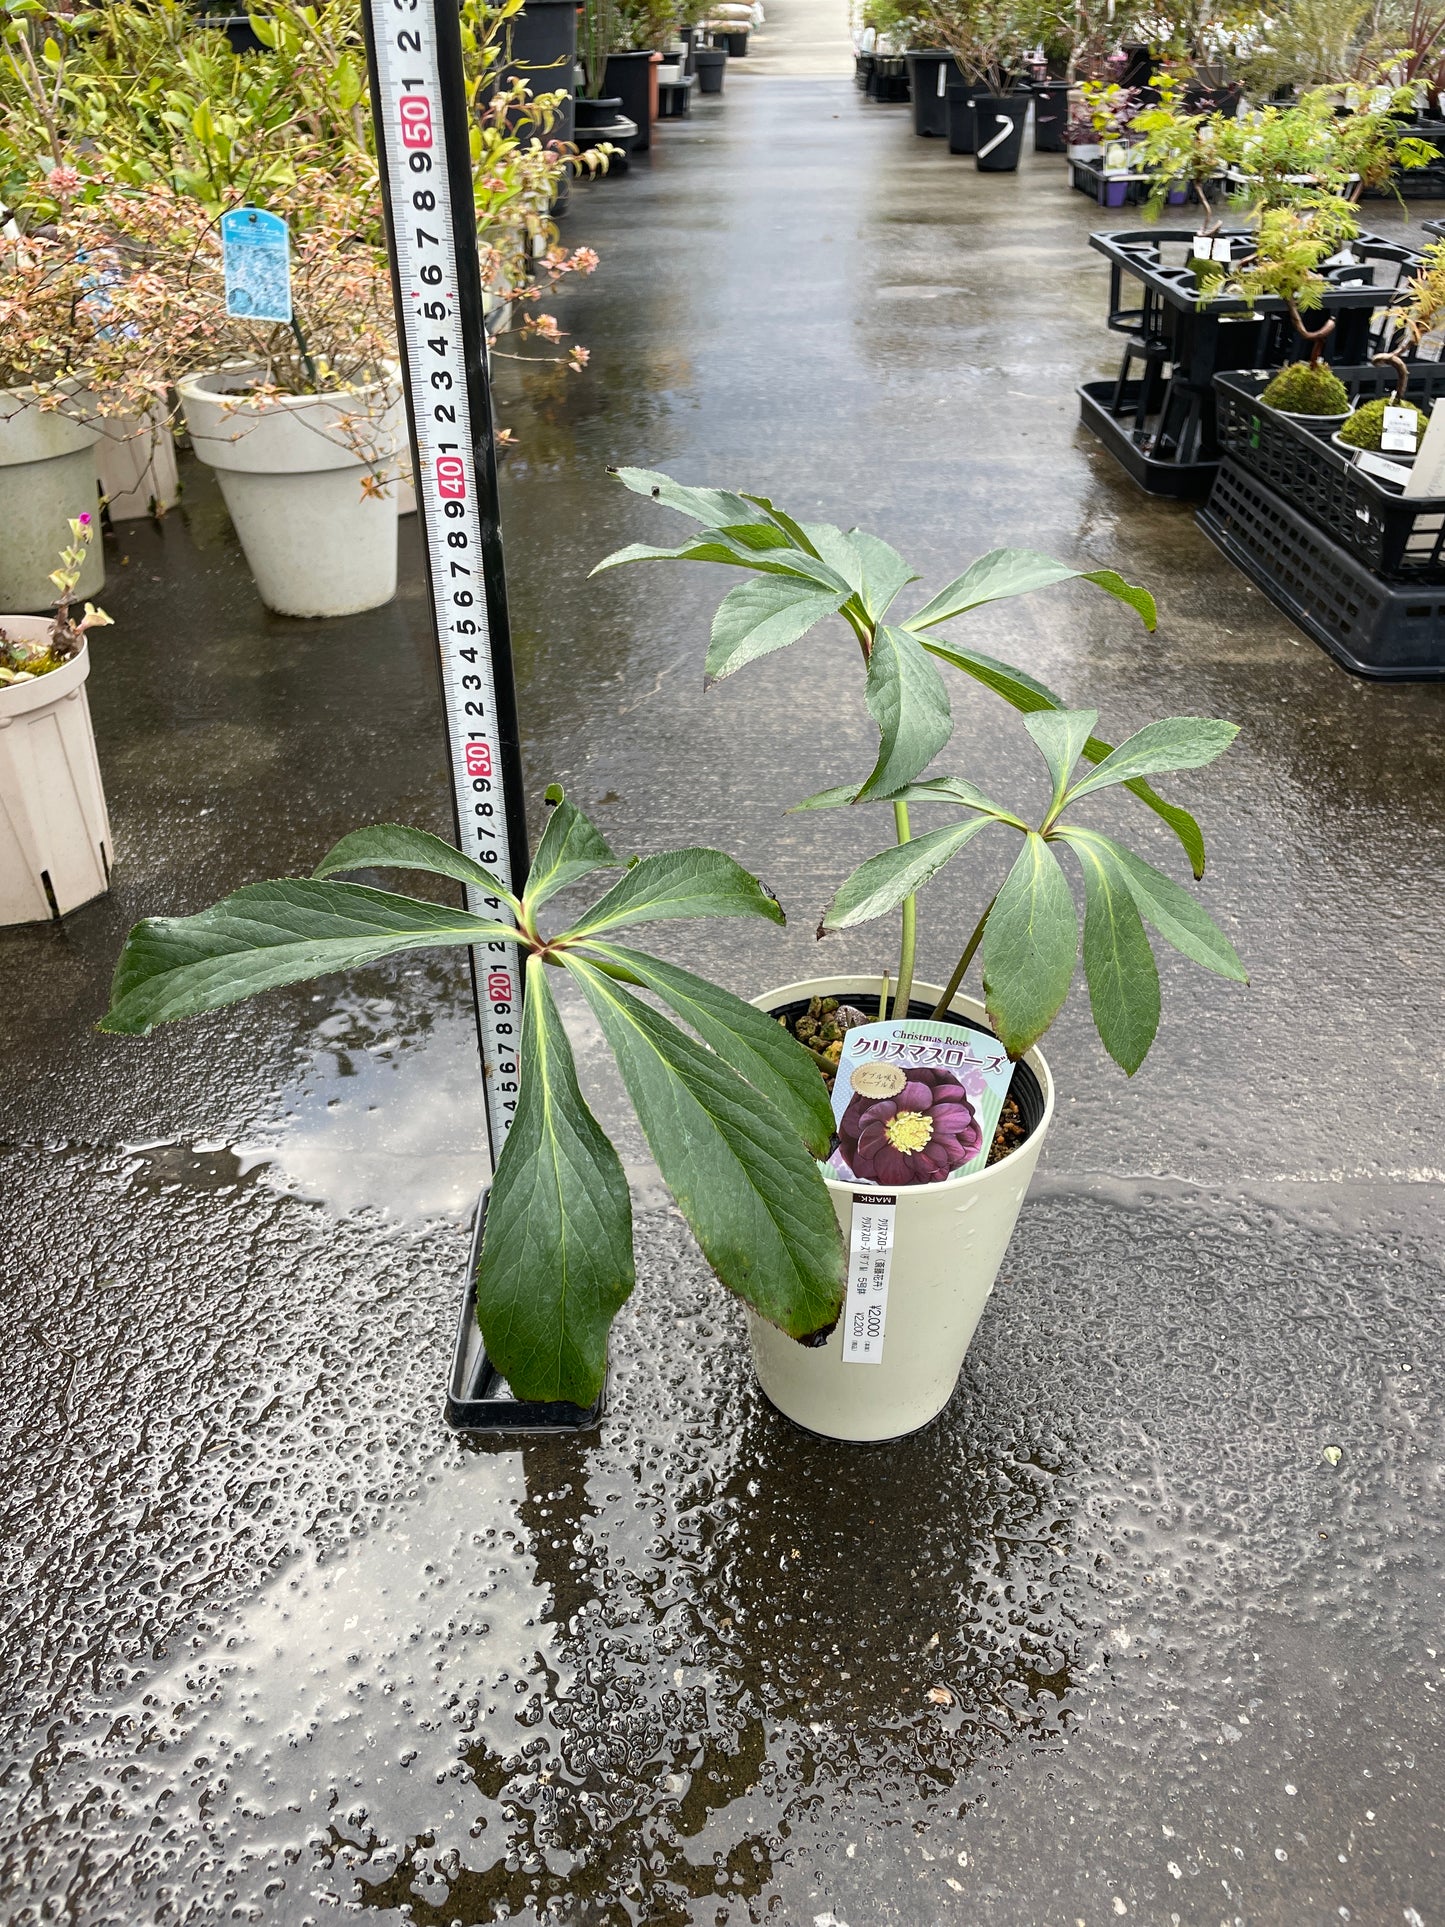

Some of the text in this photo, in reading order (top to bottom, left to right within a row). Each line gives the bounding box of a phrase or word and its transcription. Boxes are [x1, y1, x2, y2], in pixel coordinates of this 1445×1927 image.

[397, 31, 422, 52] 2
[401, 78, 424, 91] 1
[402, 103, 431, 142] 50
[409, 152, 432, 173] 9
[413, 191, 436, 211] 8
[416, 228, 439, 248] 7
[420, 265, 443, 285] 6
[424, 301, 446, 321] 5
[428, 336, 449, 356] 4
[431, 371, 453, 390] 3
[434, 404, 456, 423] 2
[438, 443, 459, 454] 1
[439, 461, 464, 494] 40
[444, 501, 465, 518] 9
[447, 531, 468, 549] 8
[450, 561, 471, 578] 7
[453, 591, 474, 607] 6
[457, 619, 476, 635] 5
[459, 647, 479, 663] 4
[462, 674, 482, 690] 3
[465, 701, 484, 717] 2
[468, 732, 486, 741] 1
[467, 746, 490, 772] 30
[472, 778, 492, 793] 9
[475, 802, 494, 817] 8
[477, 827, 496, 840] 7
[480, 850, 498, 864] 6
[484, 896, 501, 909] 4
[491, 964, 507, 972] 1
[490, 976, 510, 998] 20
[494, 1003, 511, 1015] 9
[496, 1022, 513, 1035] 8
[892, 1029, 969, 1047] Christmas Rose
[498, 1043, 515, 1054] 7
[852, 1037, 1007, 1074] クリスマスローズ
[500, 1062, 516, 1074] 6
[502, 1082, 518, 1093] 5
[503, 1100, 517, 1111] 4
[867, 1305, 882, 1337] ¥2,000
